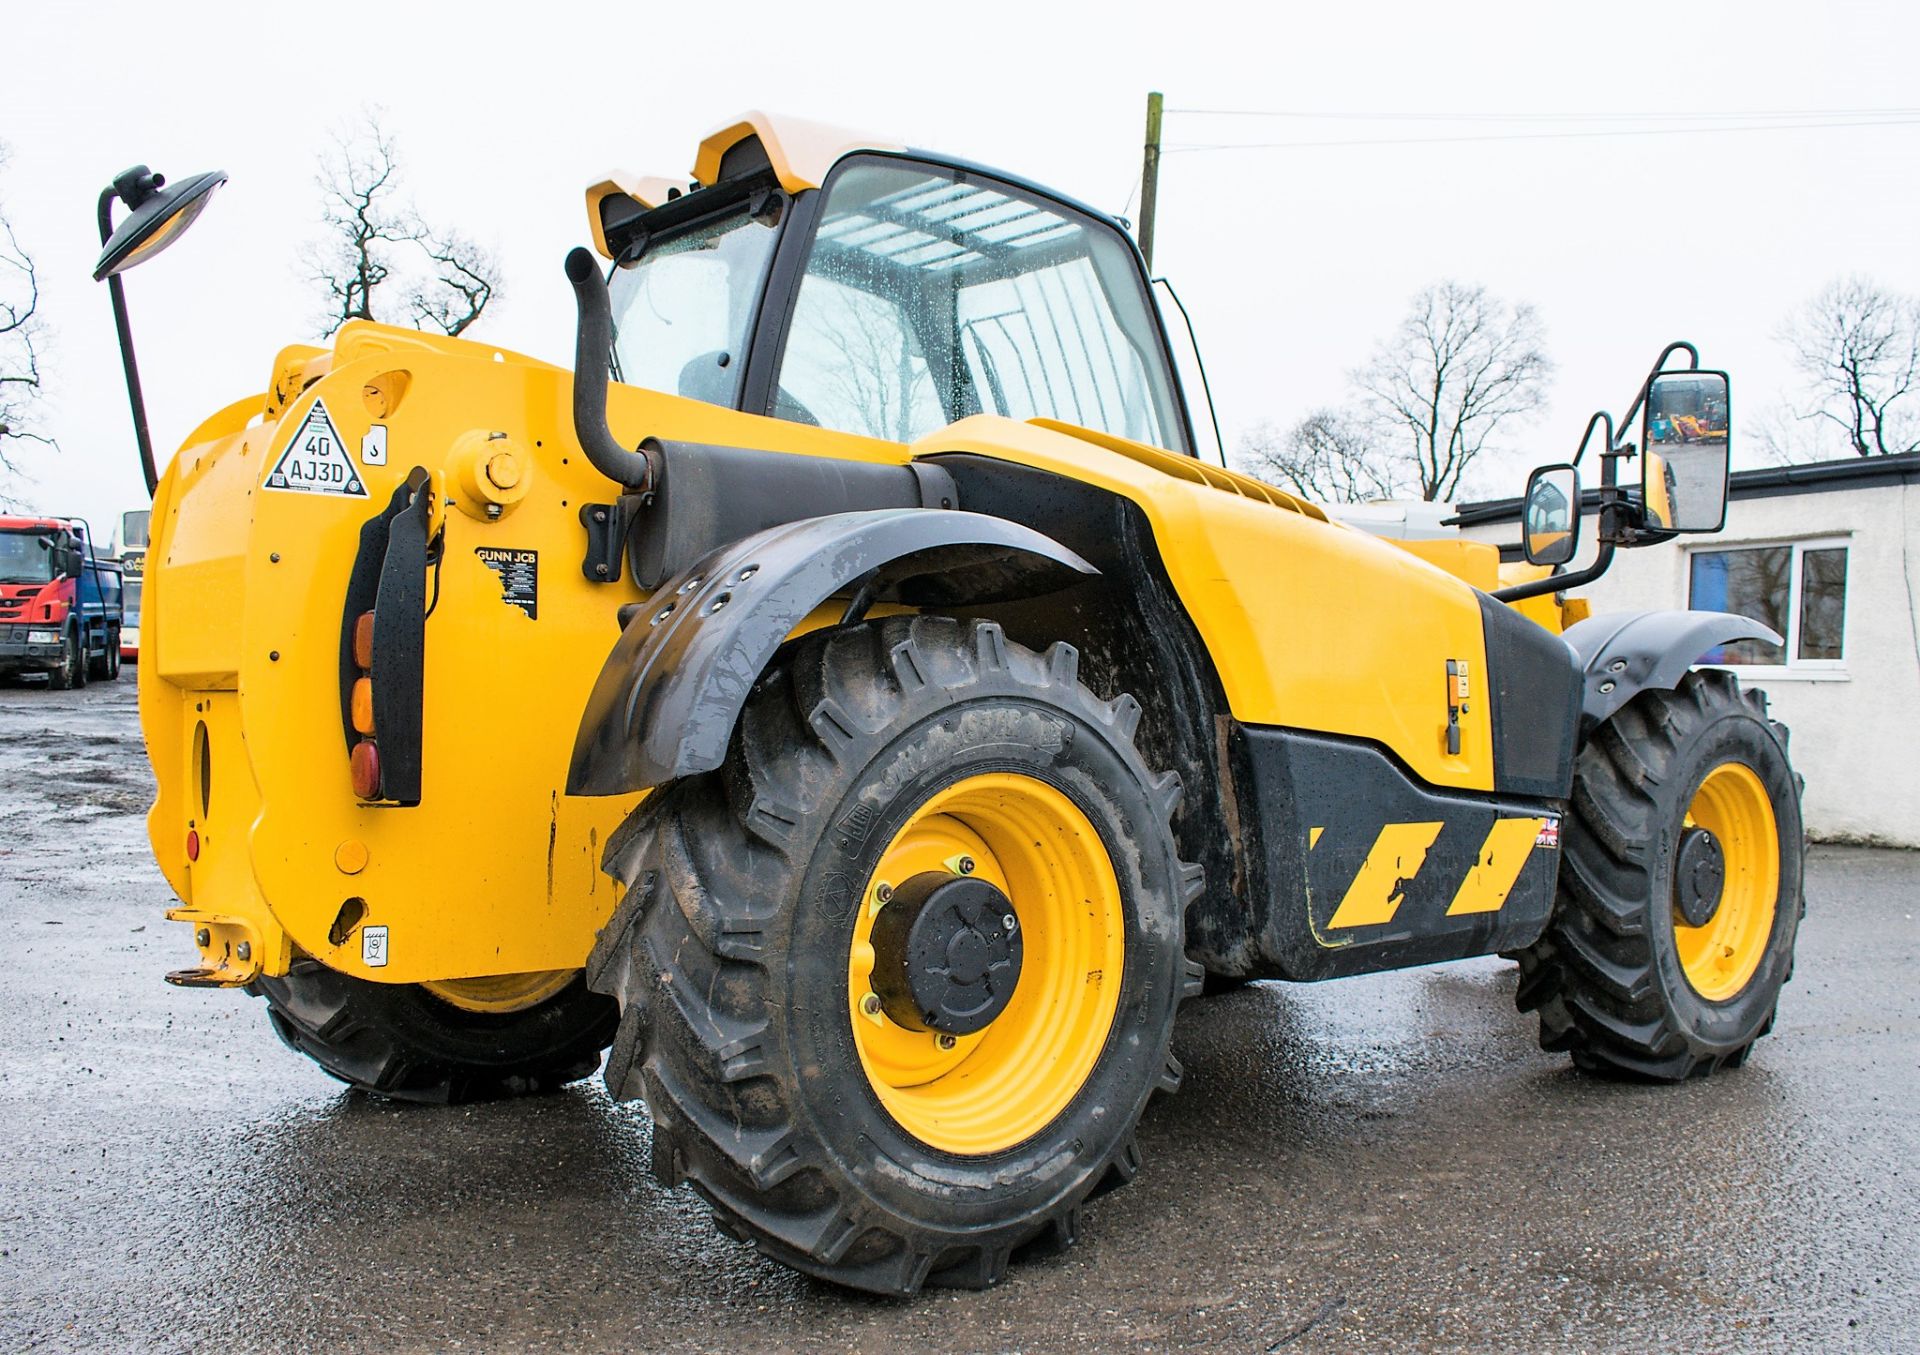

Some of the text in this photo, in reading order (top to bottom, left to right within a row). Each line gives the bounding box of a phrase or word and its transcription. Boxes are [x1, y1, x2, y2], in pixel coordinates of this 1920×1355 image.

[291, 460, 343, 482] AJ3D
[478, 550, 536, 563] GUNN JCB
[841, 804, 871, 836] JCB
